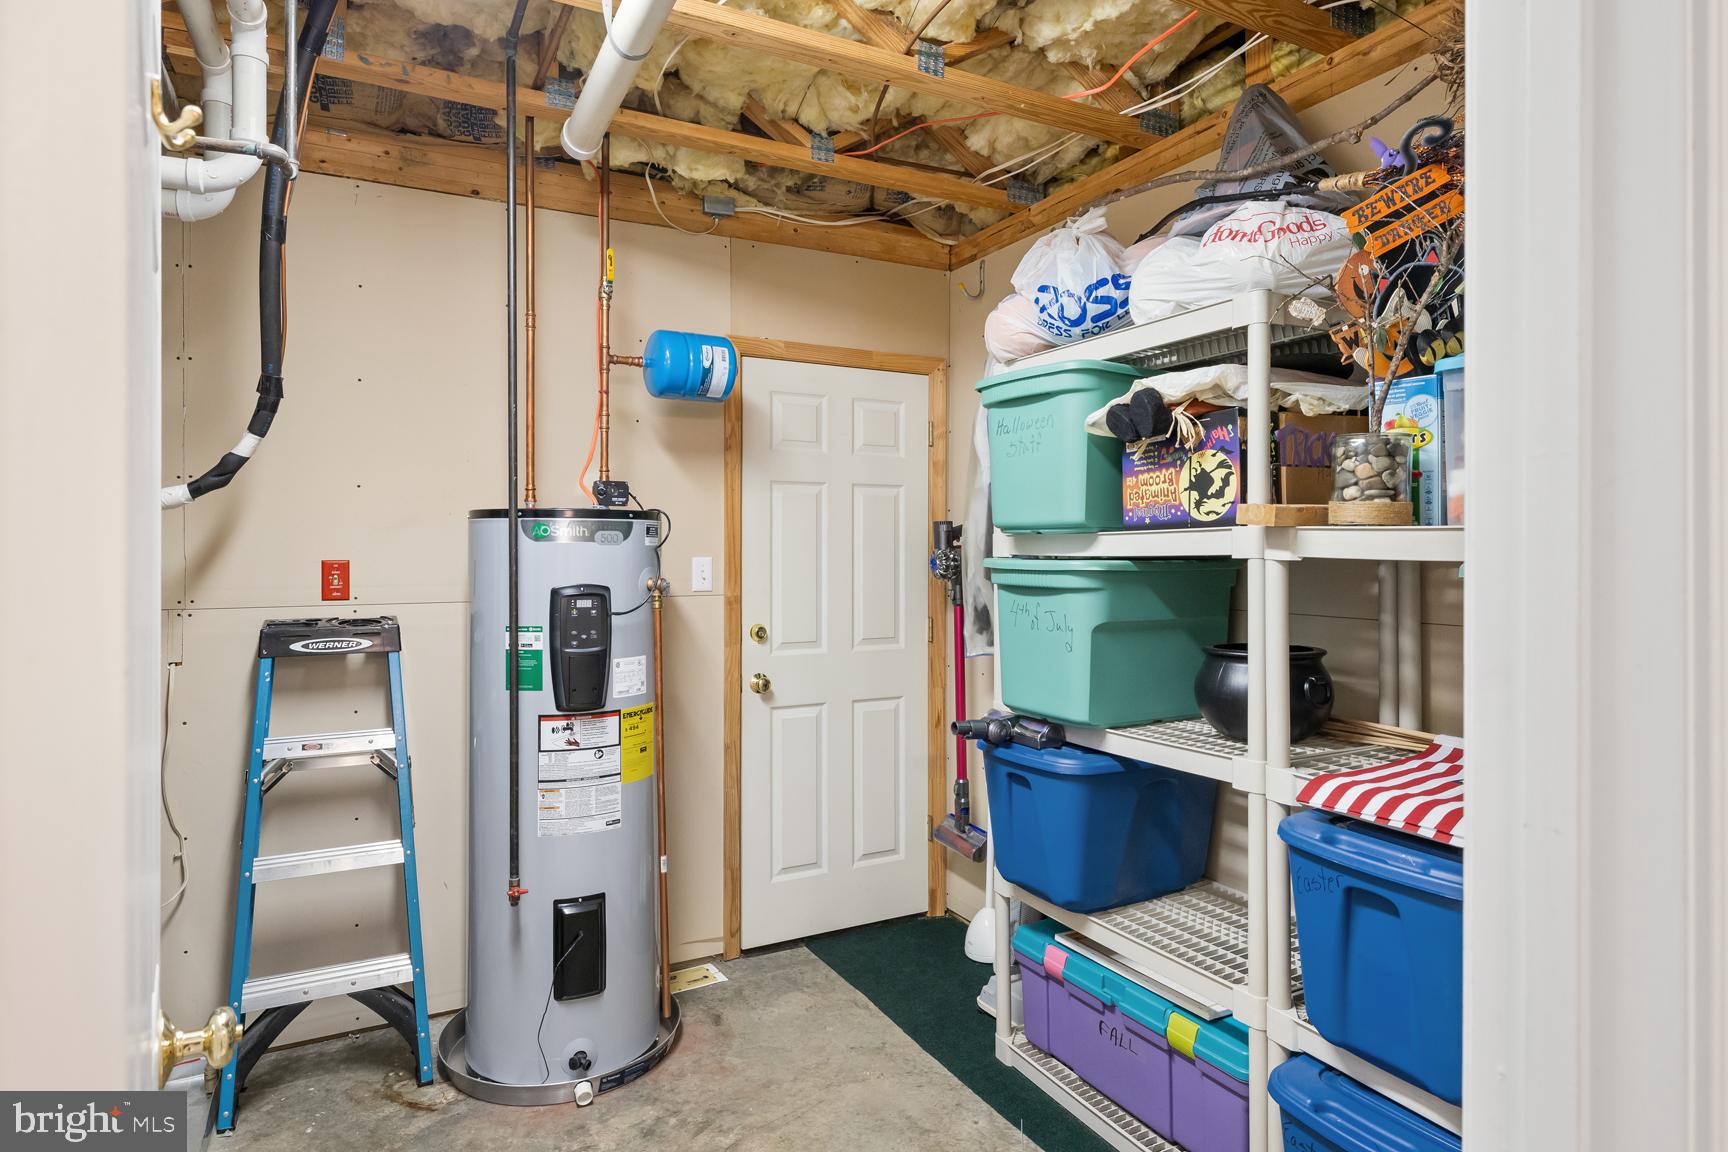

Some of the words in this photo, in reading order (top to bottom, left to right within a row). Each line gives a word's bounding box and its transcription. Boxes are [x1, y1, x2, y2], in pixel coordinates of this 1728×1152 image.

[1352, 168, 1436, 227] BEWARE
[1375, 199, 1452, 249] DANGER
[1288, 231, 1333, 249] Happy
[1081, 320, 1111, 338] FOR
[996, 414, 1055, 437] Halloween
[1140, 471, 1174, 487] Broom
[1128, 486, 1178, 506] Animated
[600, 533, 620, 545] 500
[1010, 599, 1030, 628] 4th
[1044, 610, 1074, 653] July
[308, 641, 357, 650] WERNER
[1296, 865, 1345, 895] Easter
[1099, 1019, 1139, 1056] FALL
